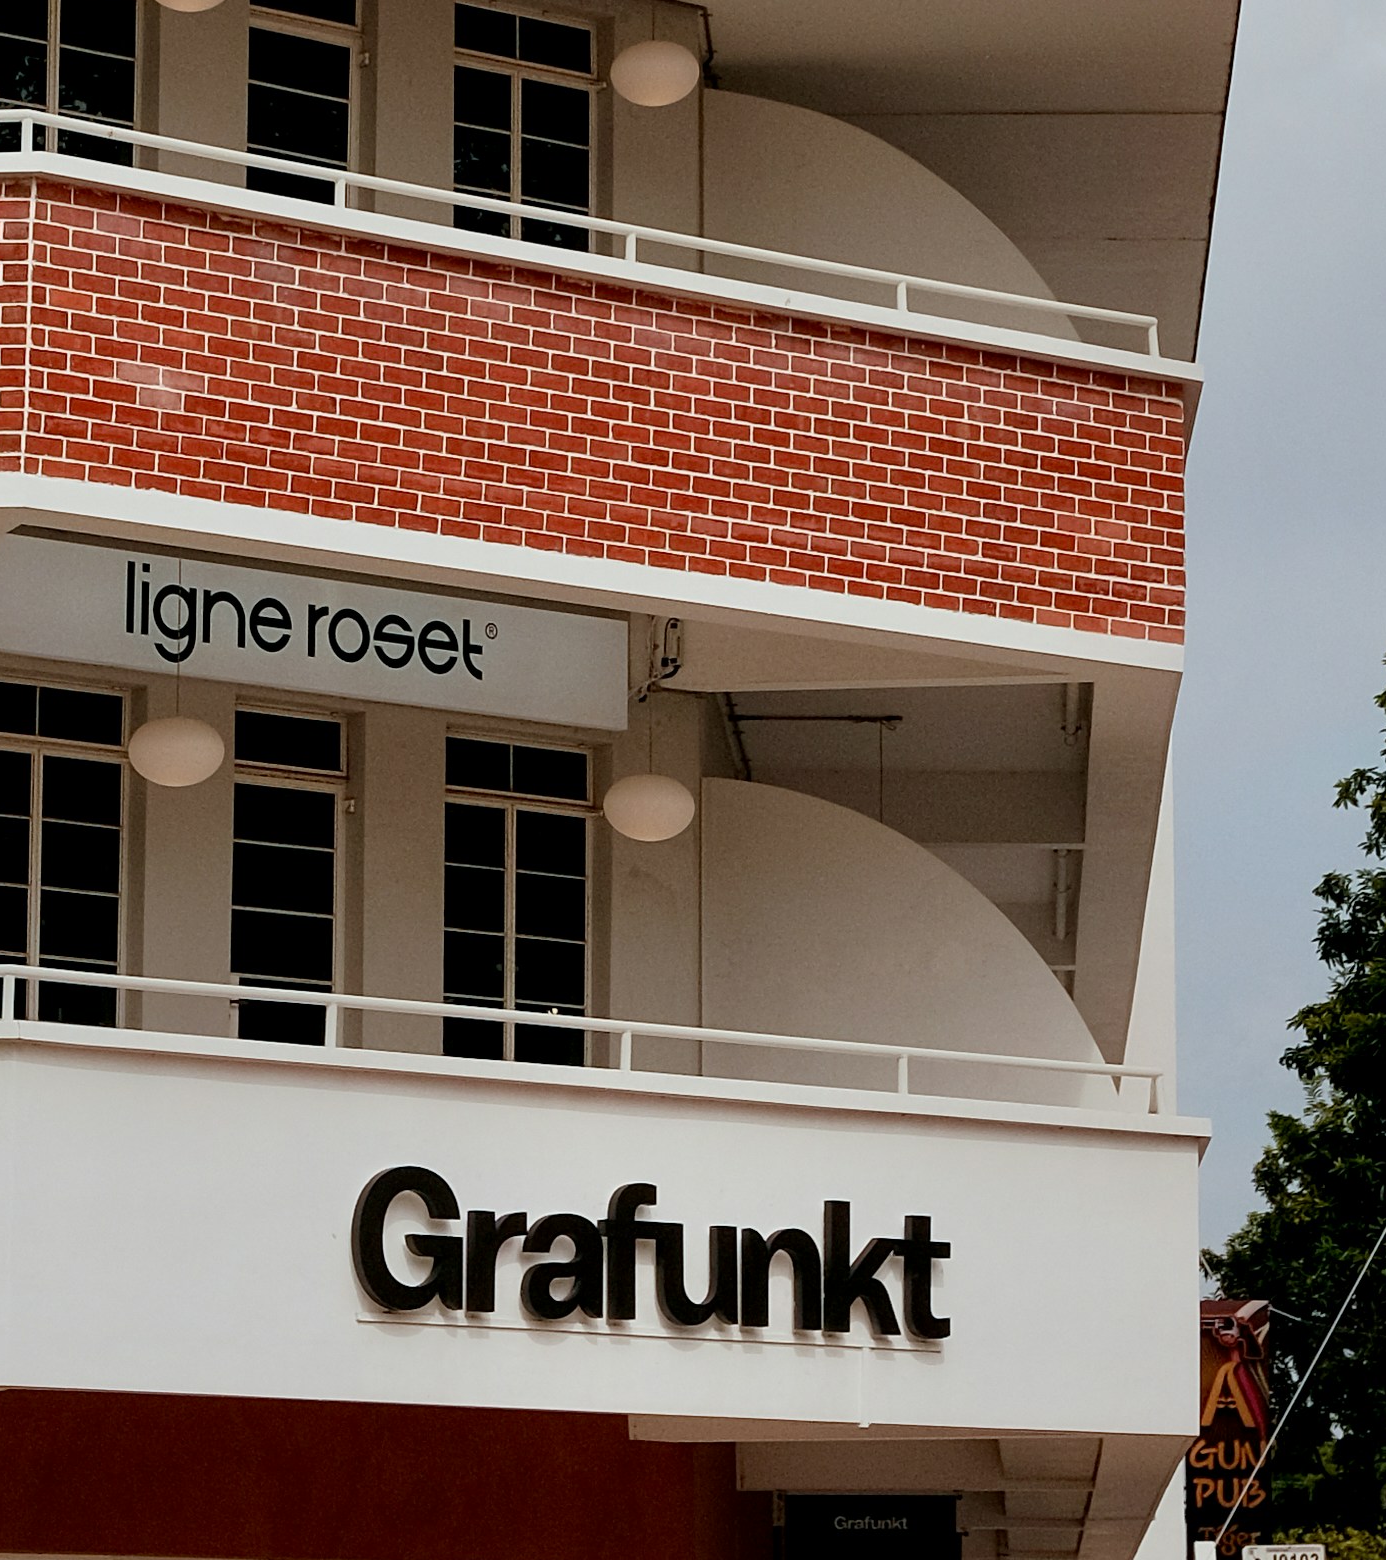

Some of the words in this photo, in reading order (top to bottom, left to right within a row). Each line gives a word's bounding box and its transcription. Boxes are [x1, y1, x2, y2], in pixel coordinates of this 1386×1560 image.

[126, 560, 293, 664] ligne
[350, 1165, 952, 1340] Grafunkt
[1188, 1438, 1267, 1471] GUN
[1192, 1476, 1266, 1509] PUB
[833, 1515, 909, 1531] Grafunkt
